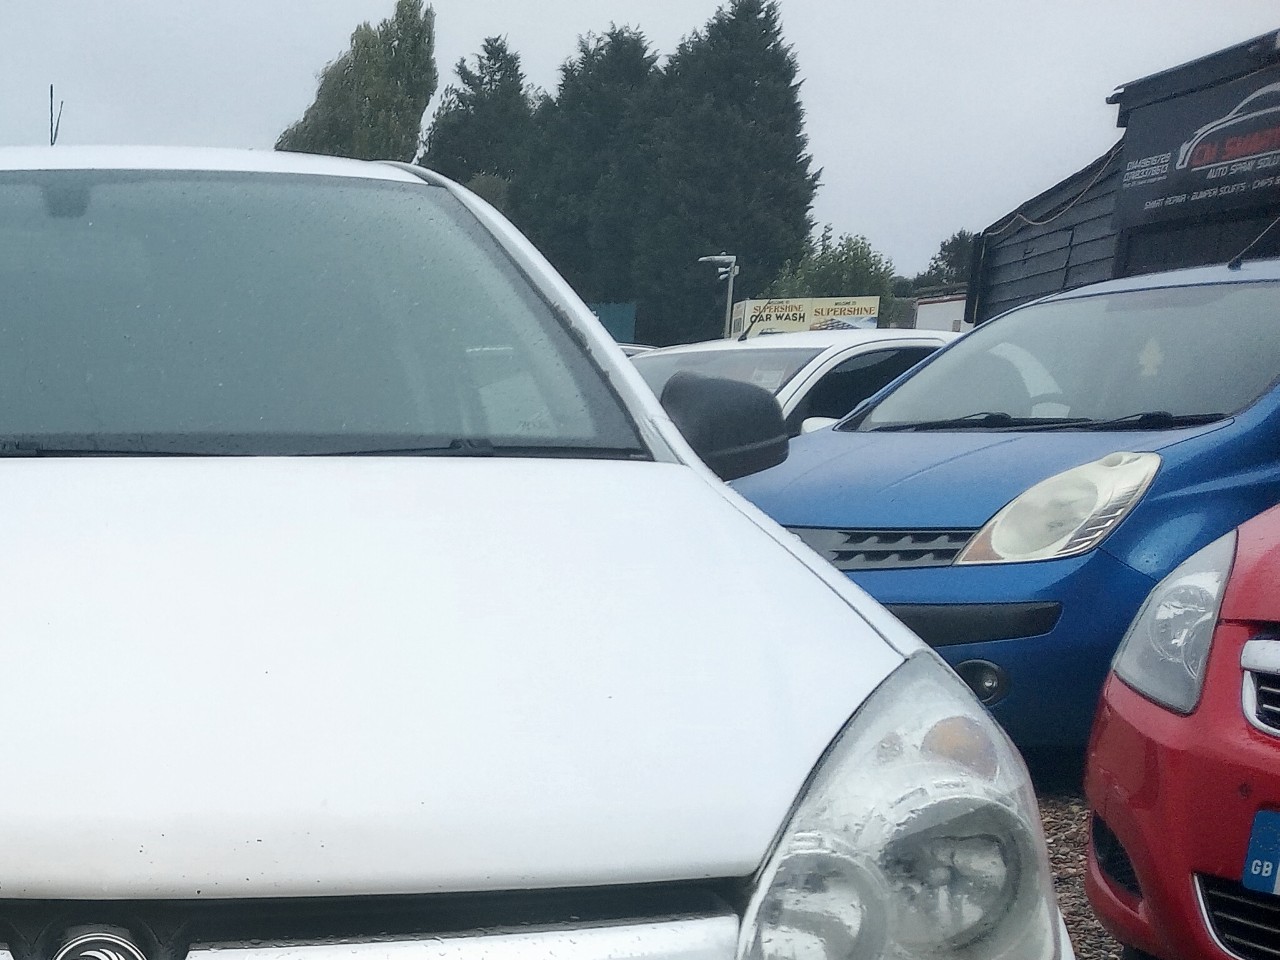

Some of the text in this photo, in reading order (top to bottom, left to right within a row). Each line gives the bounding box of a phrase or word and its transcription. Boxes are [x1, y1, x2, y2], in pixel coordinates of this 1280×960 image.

[1206, 167, 1228, 180] AUTO
[753, 304, 804, 314] SUPERSHINE
[813, 306, 876, 317] SUPERSHINE
[750, 312, 806, 324] CAR WASH
[1251, 859, 1273, 877] GB
